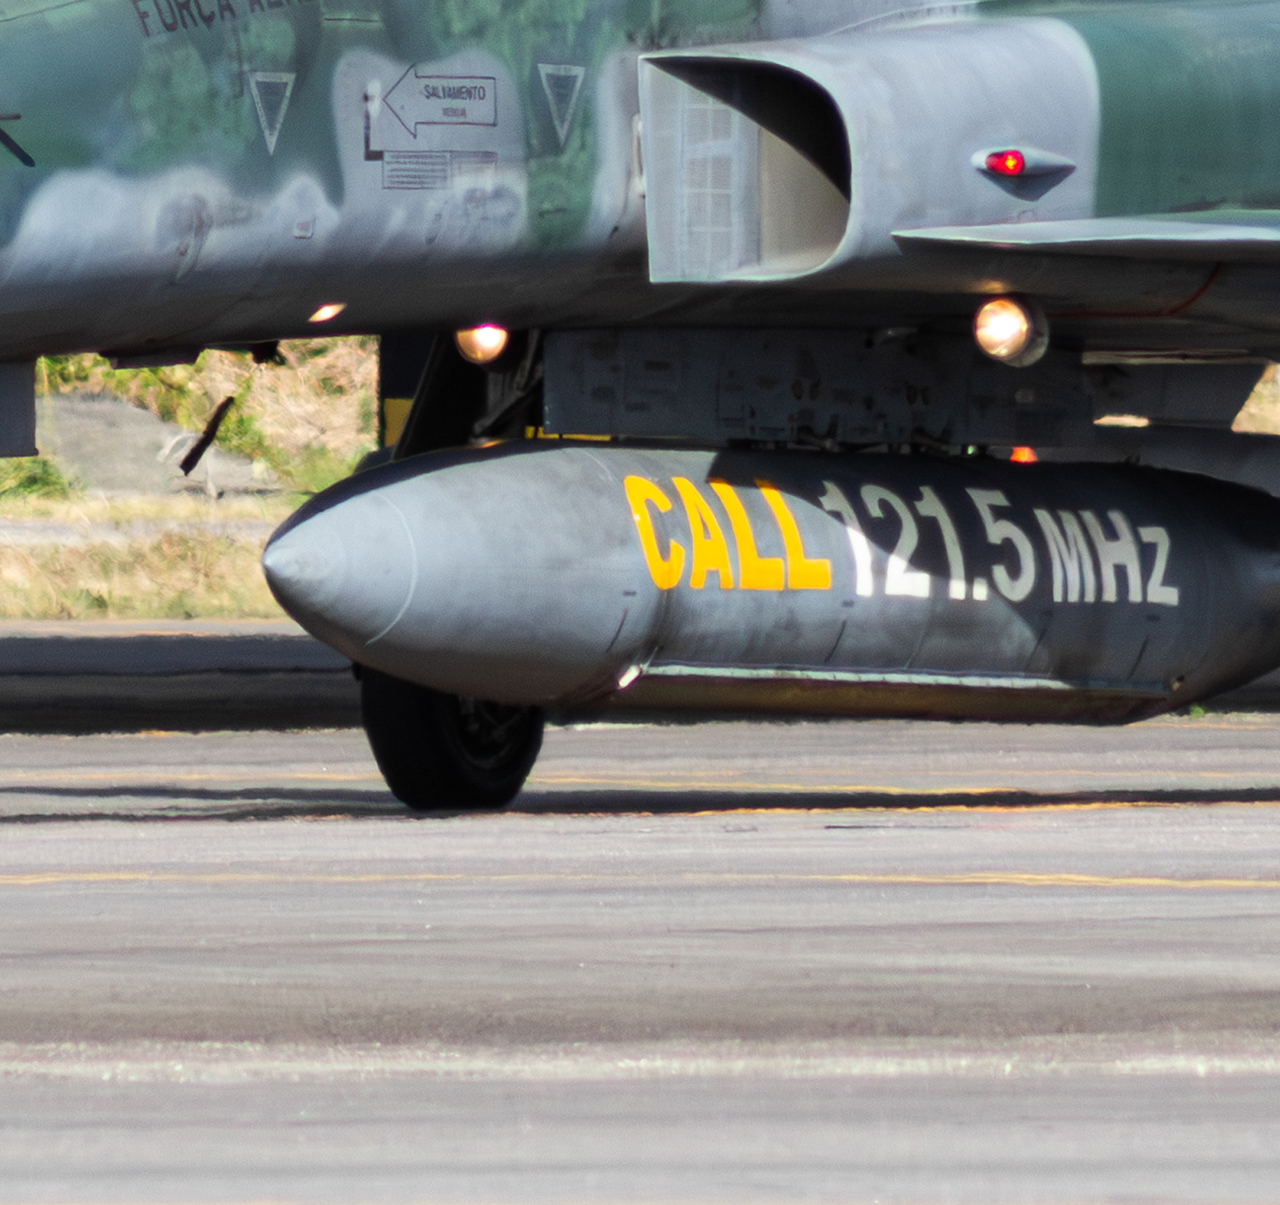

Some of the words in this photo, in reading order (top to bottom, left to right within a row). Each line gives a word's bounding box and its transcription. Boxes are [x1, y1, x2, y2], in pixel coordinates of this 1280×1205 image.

[624, 475, 831, 590] CALL
[819, 481, 1037, 601] 121.5
[1034, 507, 1179, 607] MHz
